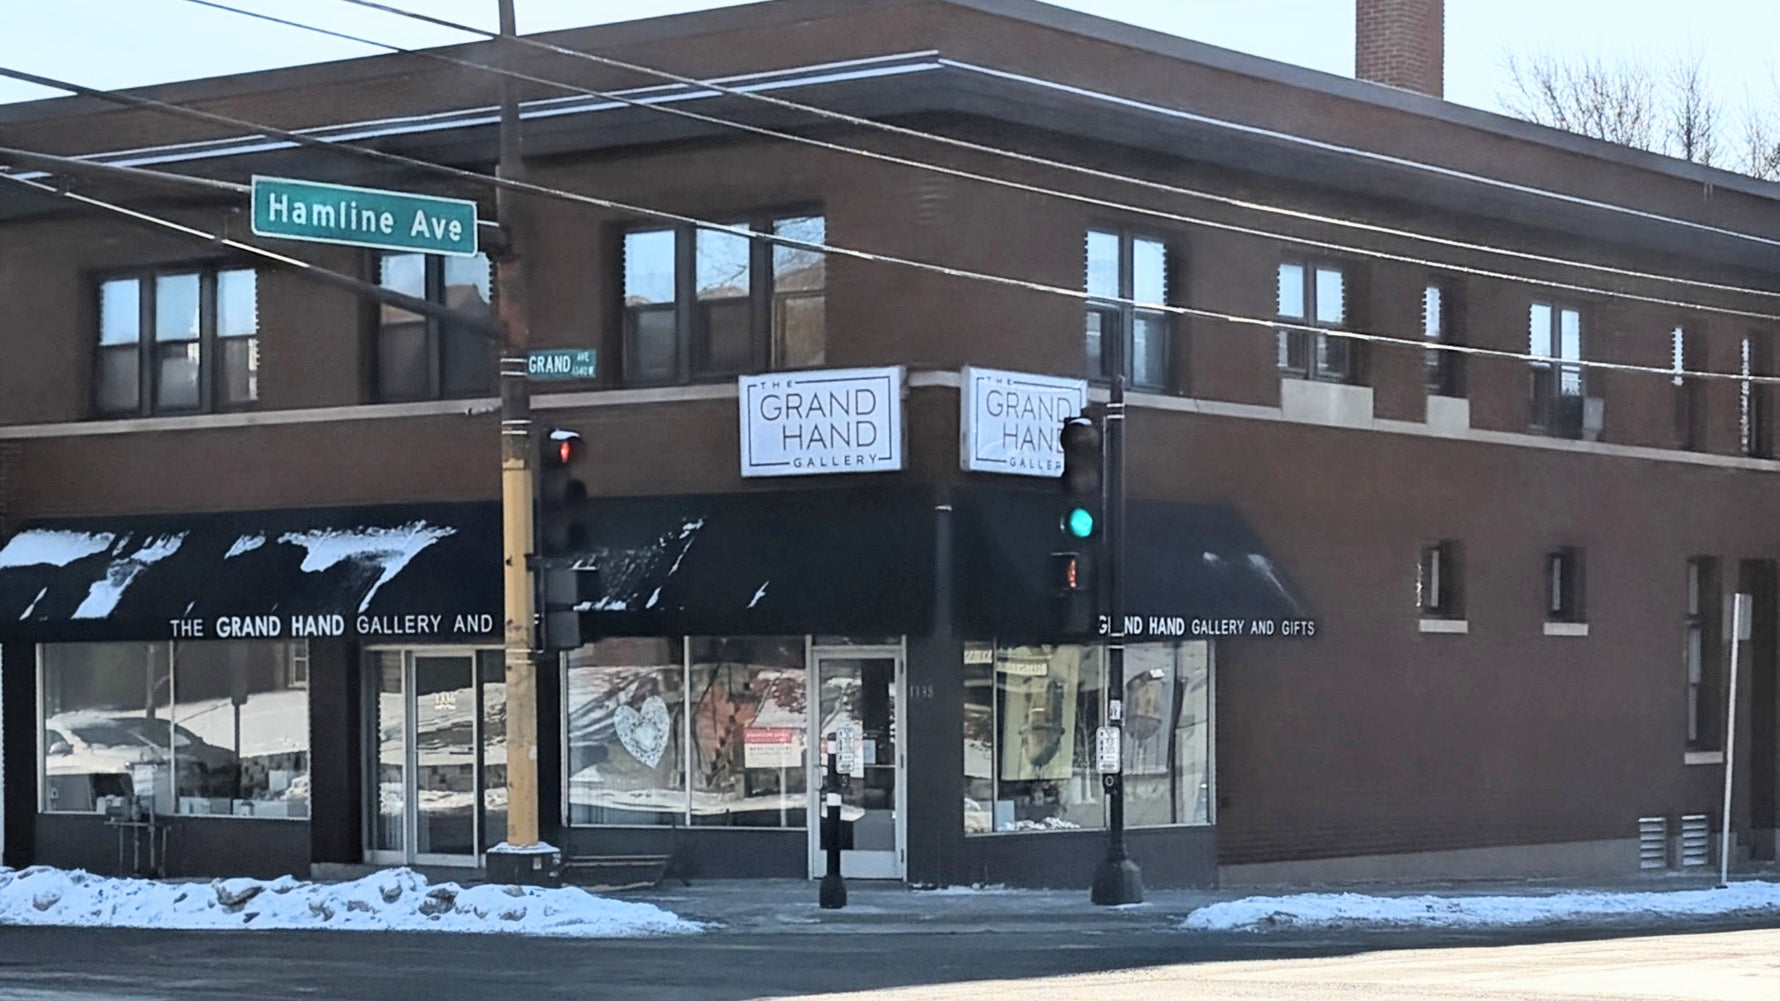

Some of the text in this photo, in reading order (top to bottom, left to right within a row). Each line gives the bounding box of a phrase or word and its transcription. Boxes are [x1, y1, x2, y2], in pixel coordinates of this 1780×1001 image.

[269, 192, 463, 242] Hamline Ave
[528, 355, 571, 374] GRAND
[761, 381, 793, 390] THE
[760, 388, 877, 421] GRAND
[986, 389, 1073, 423] GRAND
[782, 420, 878, 450] HAND
[793, 453, 878, 468] GALLERY
[1009, 457, 1063, 471] GALLER
[169, 613, 493, 638] THE GRAND HAND GALLERY AND
[1099, 615, 1315, 636] GND HAND GALLERY AND GIFTS
